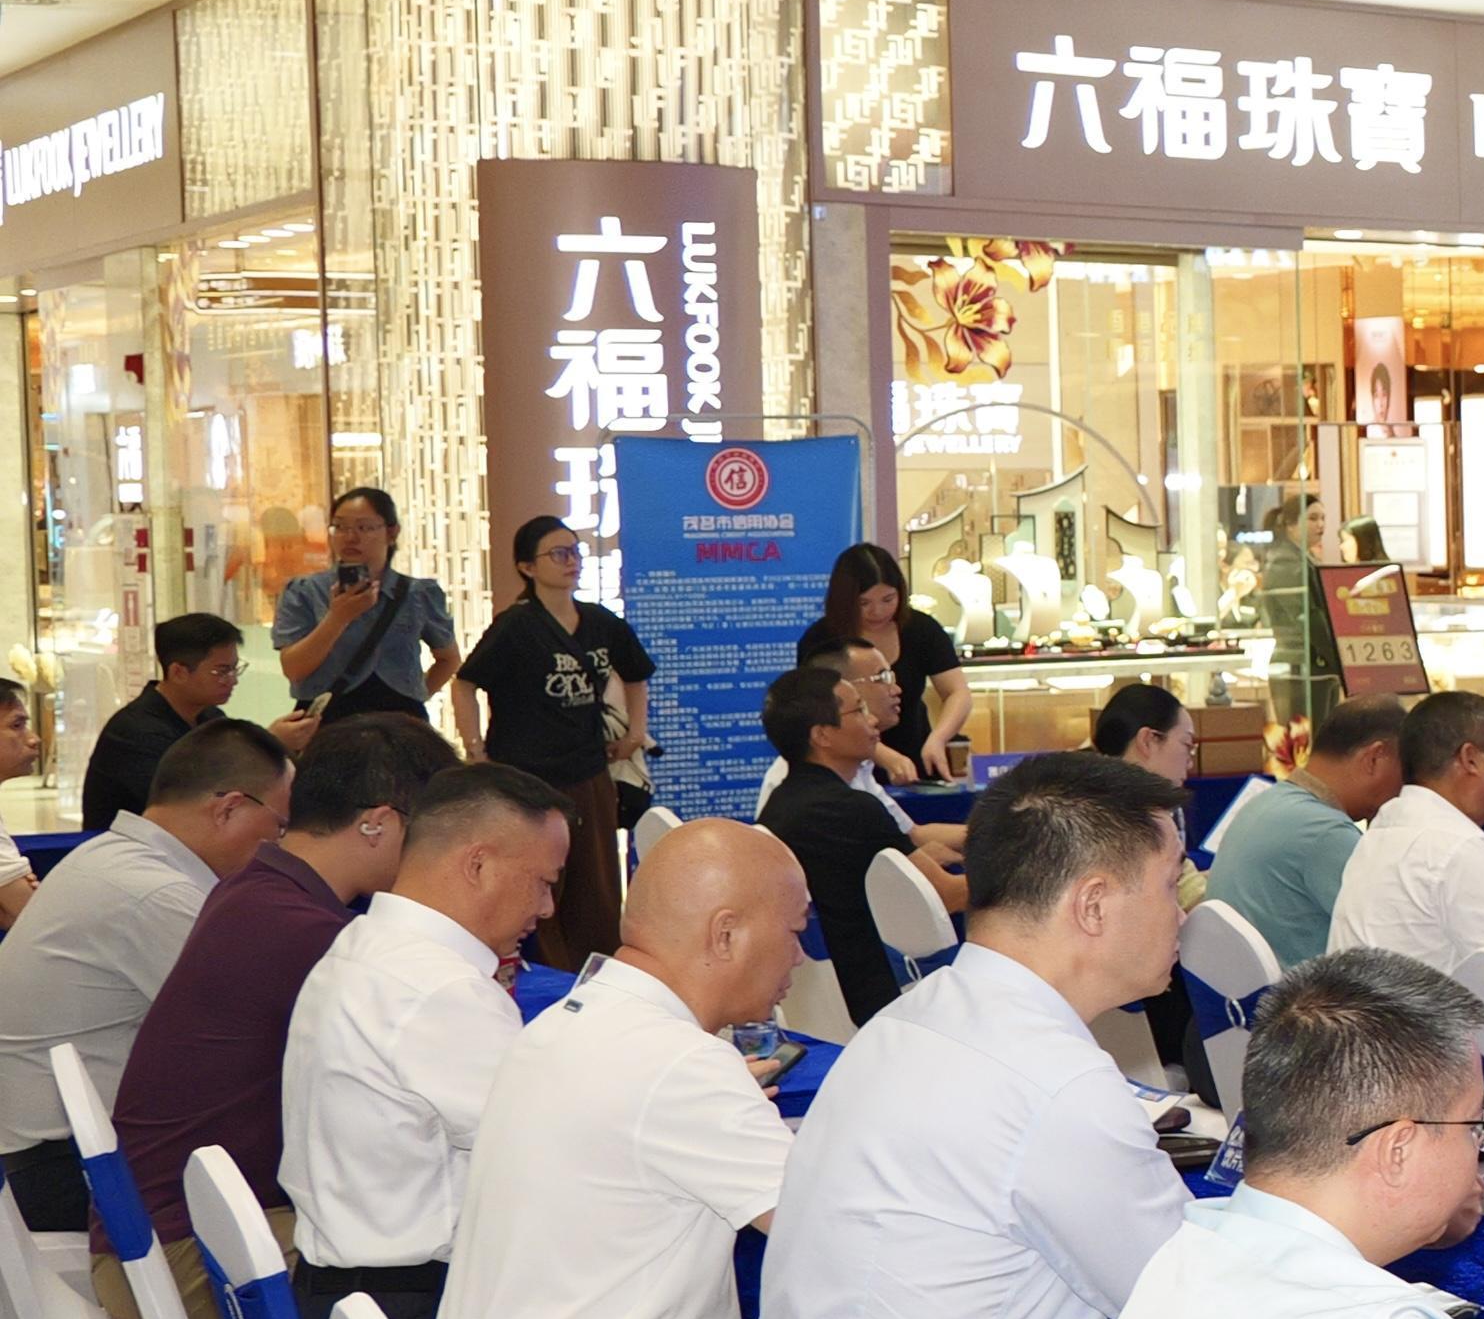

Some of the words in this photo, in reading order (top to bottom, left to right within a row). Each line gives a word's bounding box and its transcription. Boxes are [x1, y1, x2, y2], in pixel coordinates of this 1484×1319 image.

[1015, 32, 1434, 177] 六福珠寶
[681, 222, 723, 412] LUKFOOK
[695, 541, 783, 564] MMCA
[1345, 640, 1414, 663] 1263
